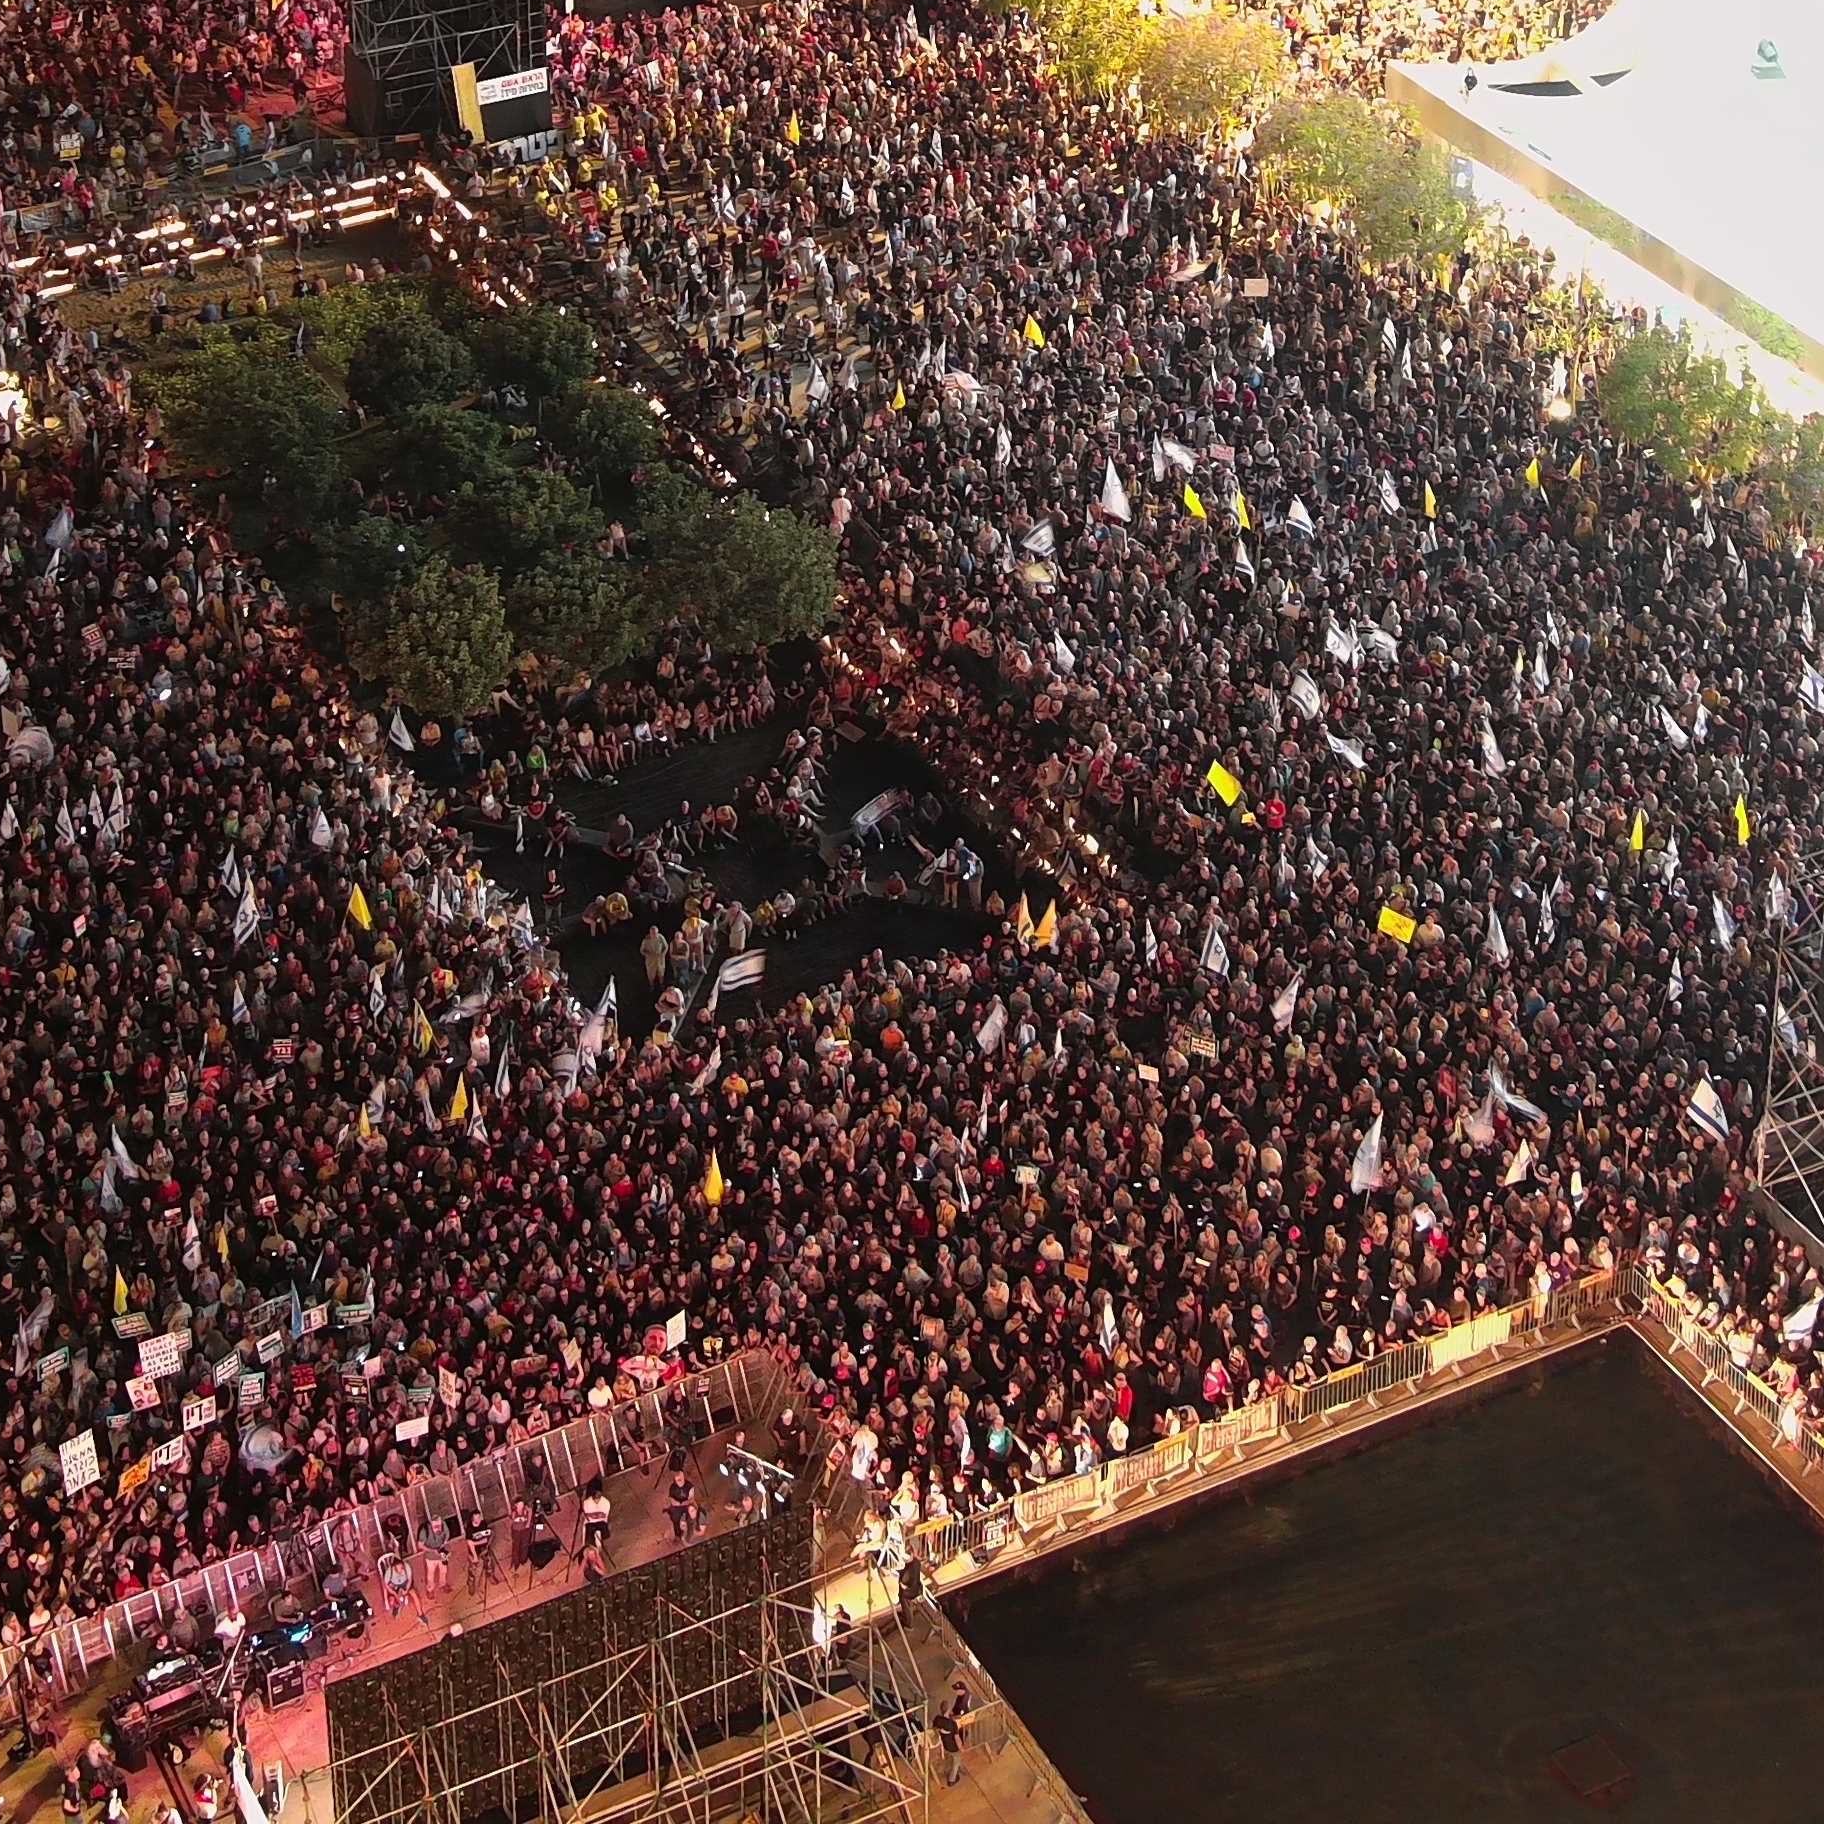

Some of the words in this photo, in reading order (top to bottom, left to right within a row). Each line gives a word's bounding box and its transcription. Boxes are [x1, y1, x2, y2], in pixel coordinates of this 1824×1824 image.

[501, 79, 519, 88] אשם
[522, 72, 544, 84] הראש
[185, 1403, 204, 1426] די!
